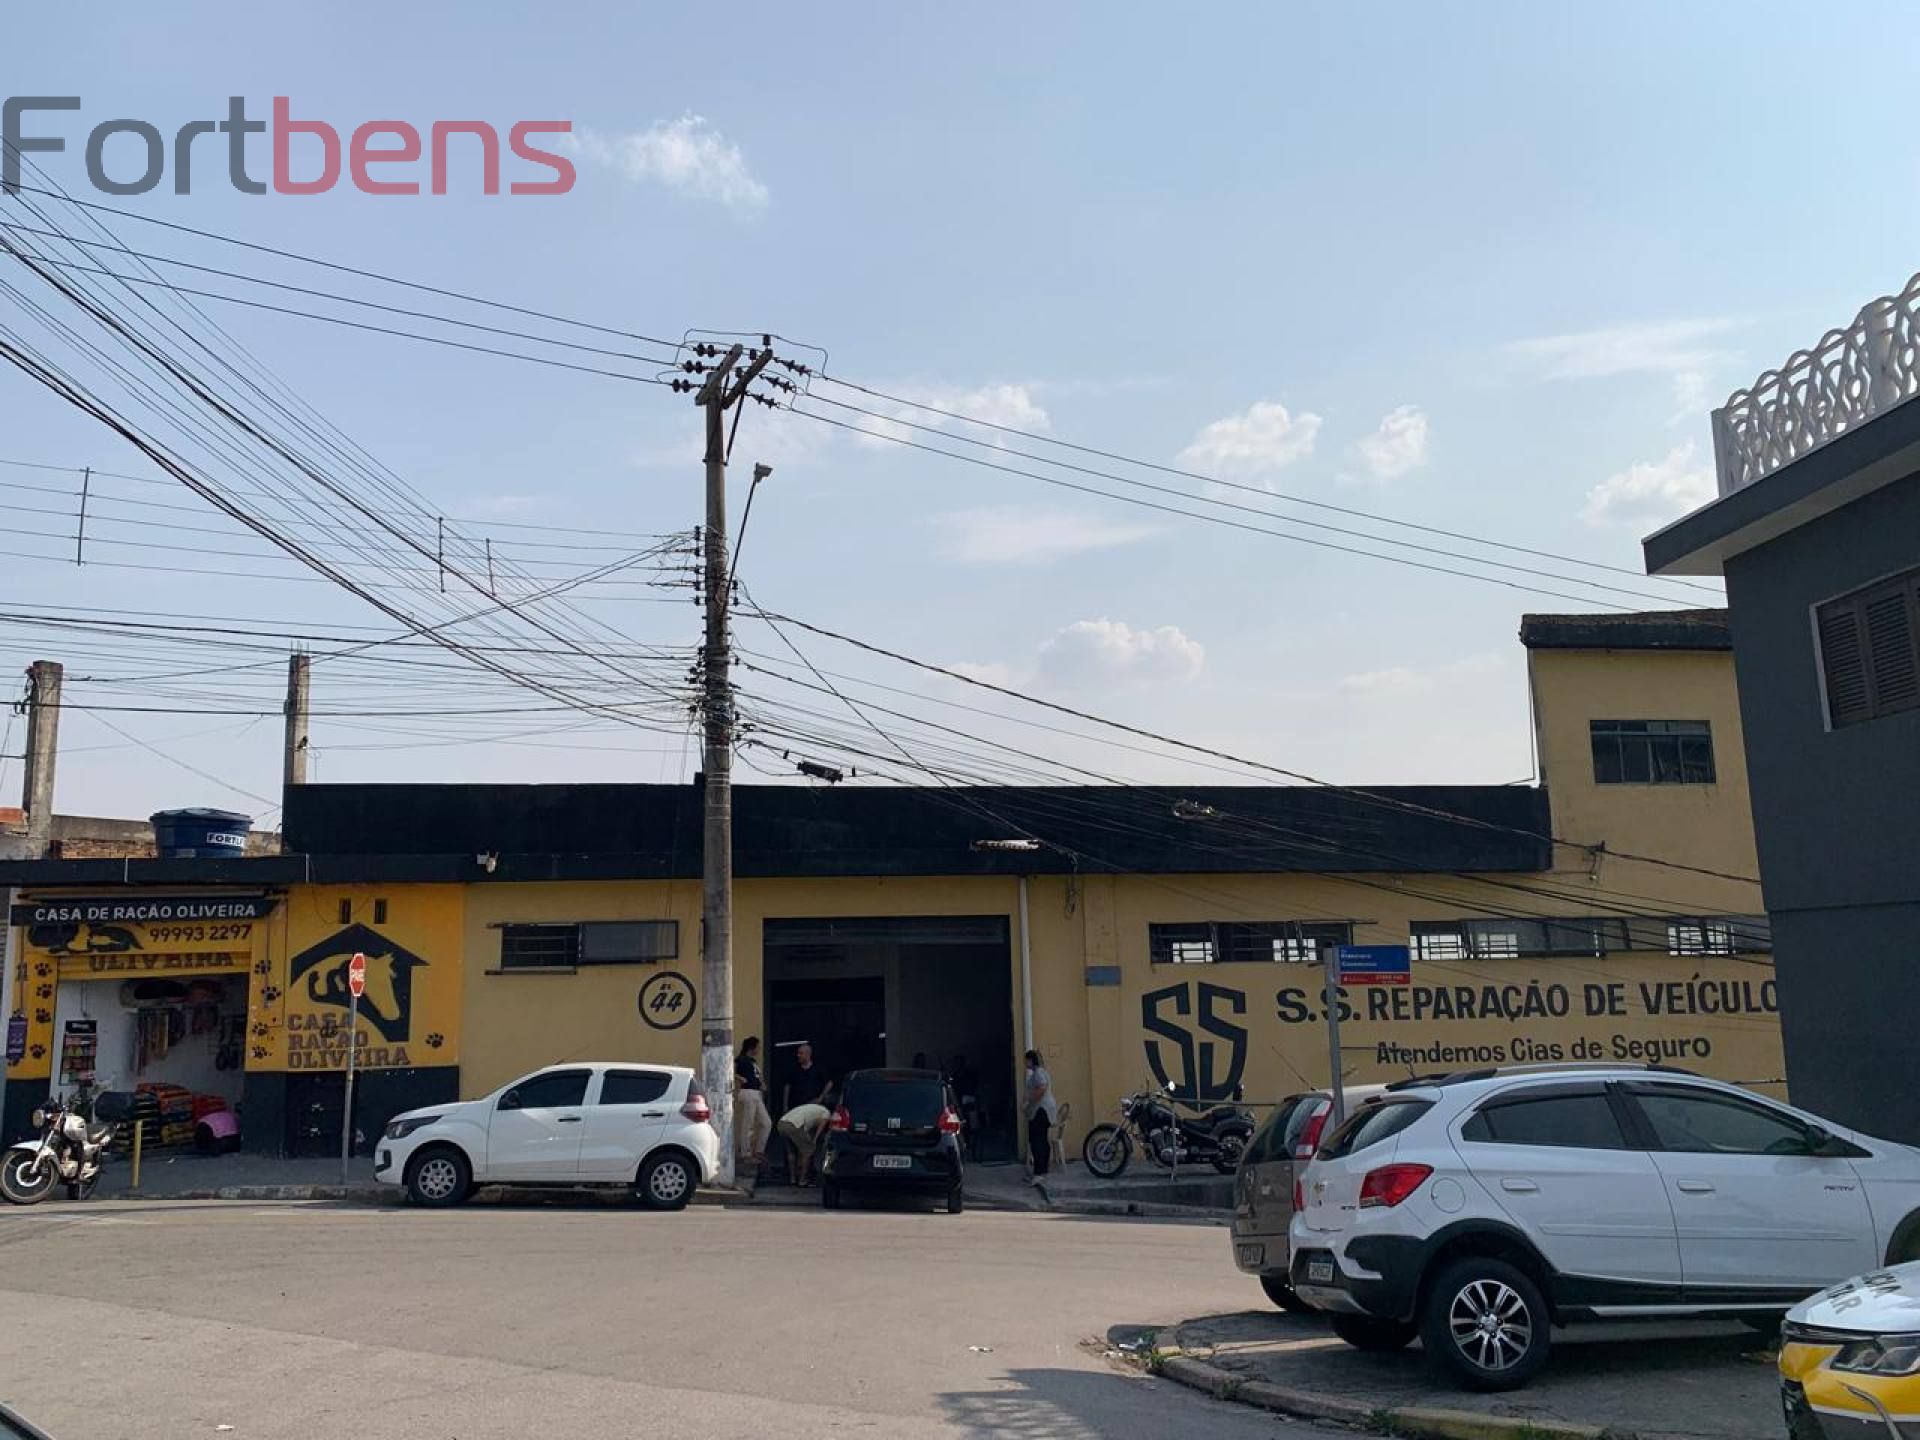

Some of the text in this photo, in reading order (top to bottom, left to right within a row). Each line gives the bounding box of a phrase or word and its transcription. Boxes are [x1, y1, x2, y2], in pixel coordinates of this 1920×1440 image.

[35, 908, 82, 921] CASA
[87, 907, 109, 919] DE
[176, 904, 256, 918] OLIVEIRA
[149, 924, 252, 942] 99993 2297
[650, 992, 684, 1012] 44
[1368, 979, 1570, 1023] REPARAÇÃO
[1584, 983, 1627, 1016] DE
[1376, 1033, 1711, 1064] Atendemos Cias de Seguro
